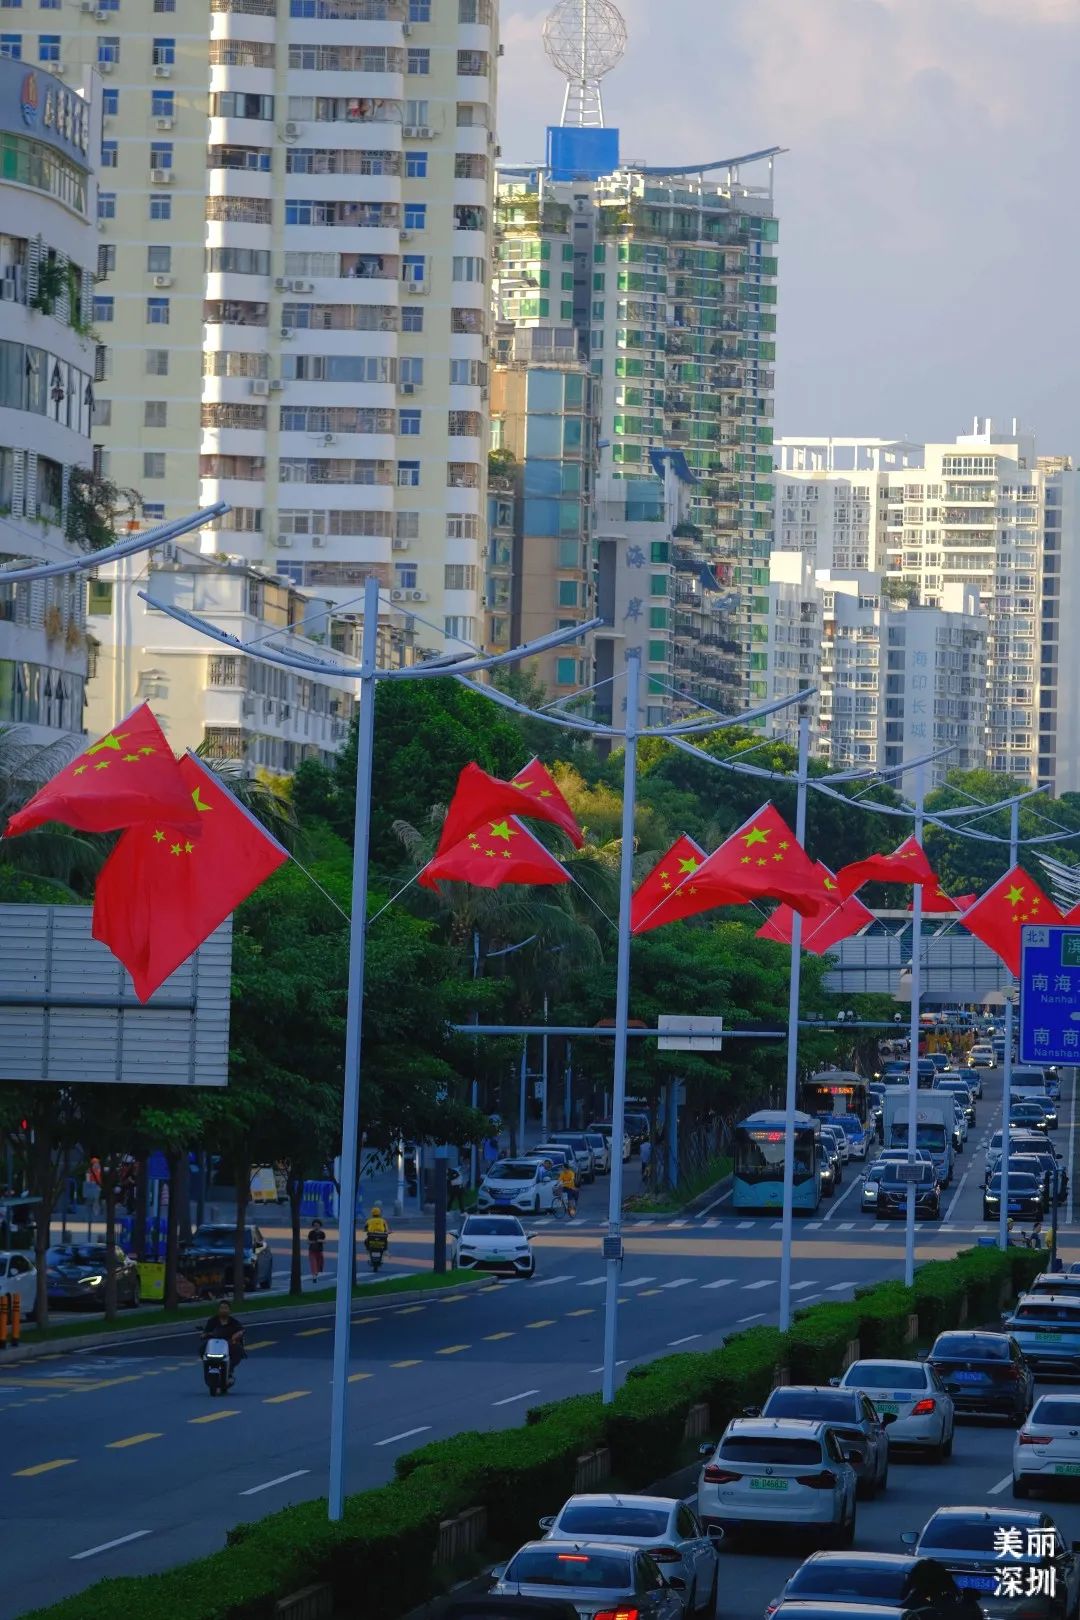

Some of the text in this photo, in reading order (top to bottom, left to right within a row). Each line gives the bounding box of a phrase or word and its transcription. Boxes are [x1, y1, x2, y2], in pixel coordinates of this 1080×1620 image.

[911, 651, 928, 738] 海印长城
[1026, 929, 1037, 943] 北
[1041, 994, 1077, 1004] Nanhai
